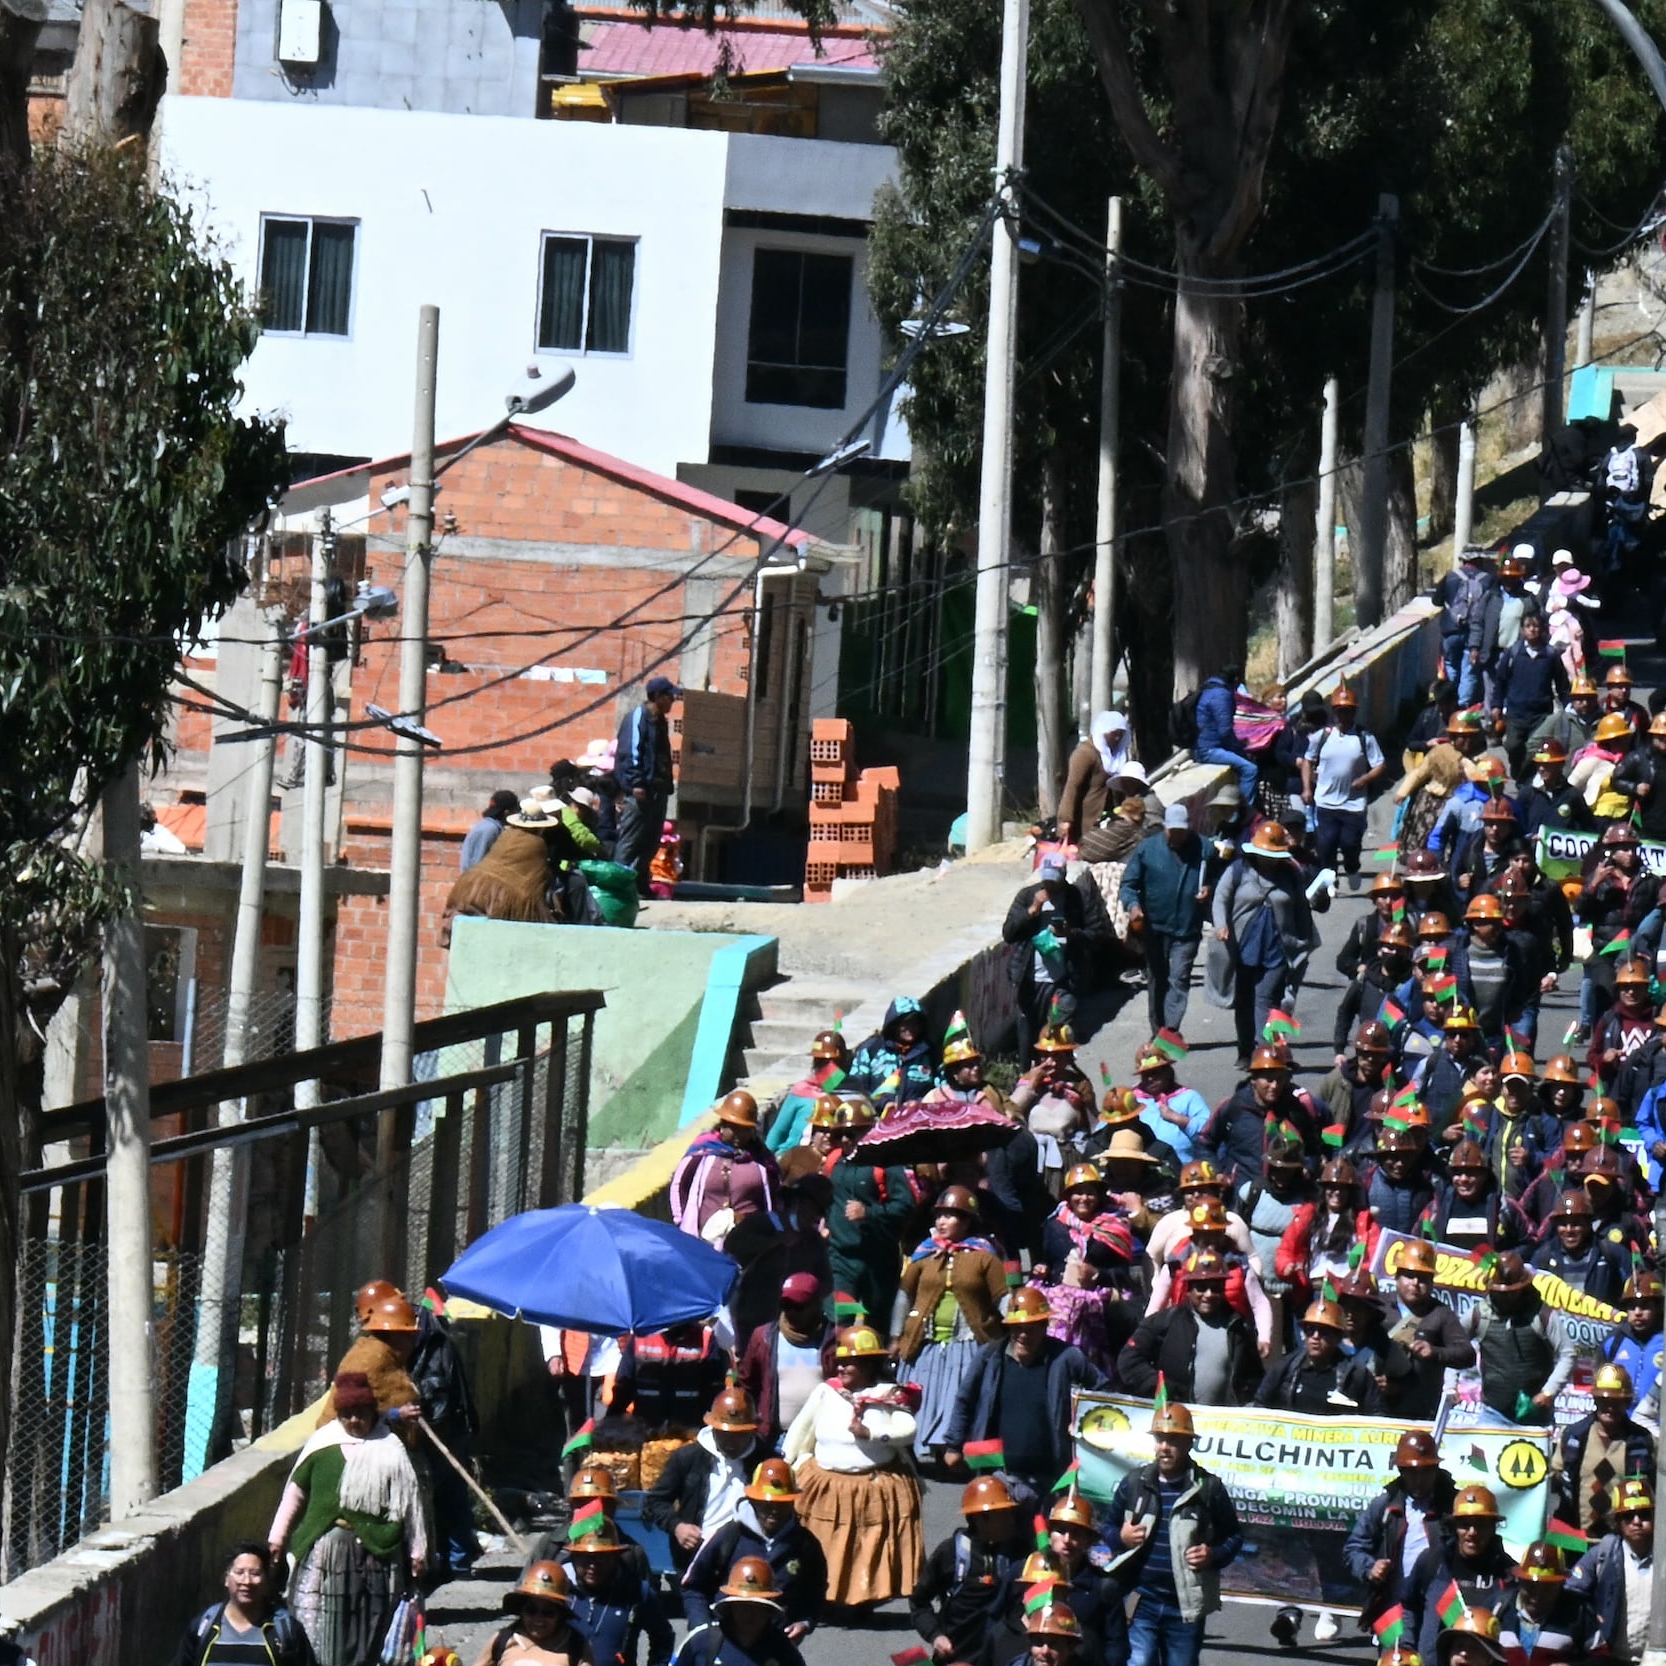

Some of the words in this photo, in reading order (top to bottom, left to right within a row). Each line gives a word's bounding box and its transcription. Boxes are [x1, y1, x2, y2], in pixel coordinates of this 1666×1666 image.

[1290, 1427, 1355, 1445] MINERA
[1359, 1430, 1403, 1446] AURI
[1193, 1436, 1375, 1471] ULLCHINTA
[1235, 1500, 1317, 1519] DECOMIN
[1327, 1509, 1350, 1522] LA
[1284, 1491, 1369, 1511] PROVINCI
